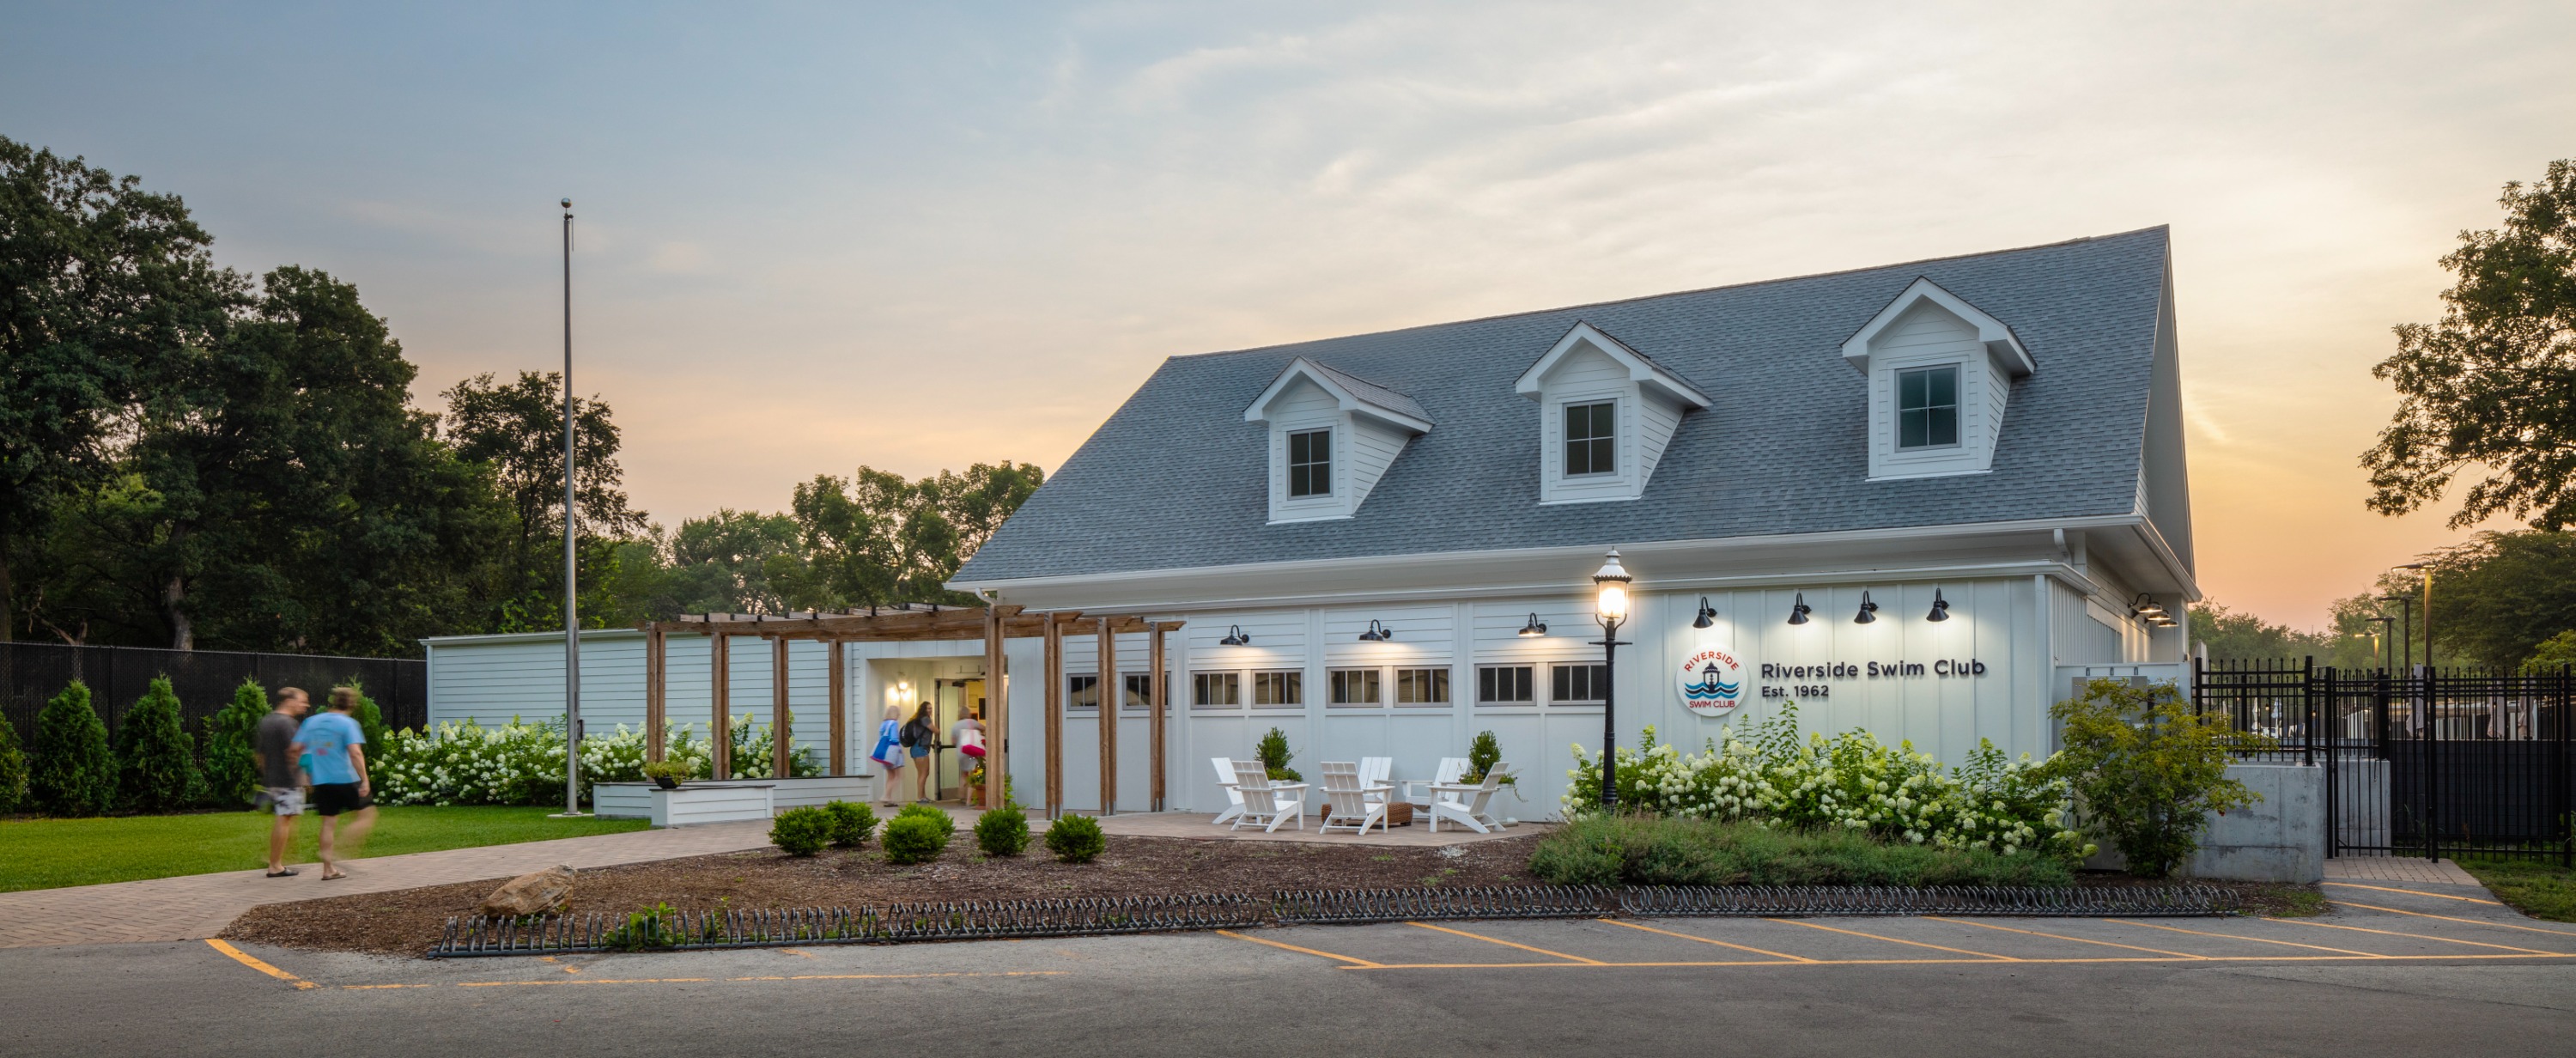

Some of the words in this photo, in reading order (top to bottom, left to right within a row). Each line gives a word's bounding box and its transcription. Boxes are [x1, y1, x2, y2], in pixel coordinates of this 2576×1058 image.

[1684, 651, 1740, 672] RIVERSIDE
[1761, 661, 1859, 678] Riverside
[1867, 660, 1924, 677] Swim
[1934, 658, 1985, 675] Club
[1761, 685, 1789, 697] Est.
[1794, 685, 1829, 697] 1962
